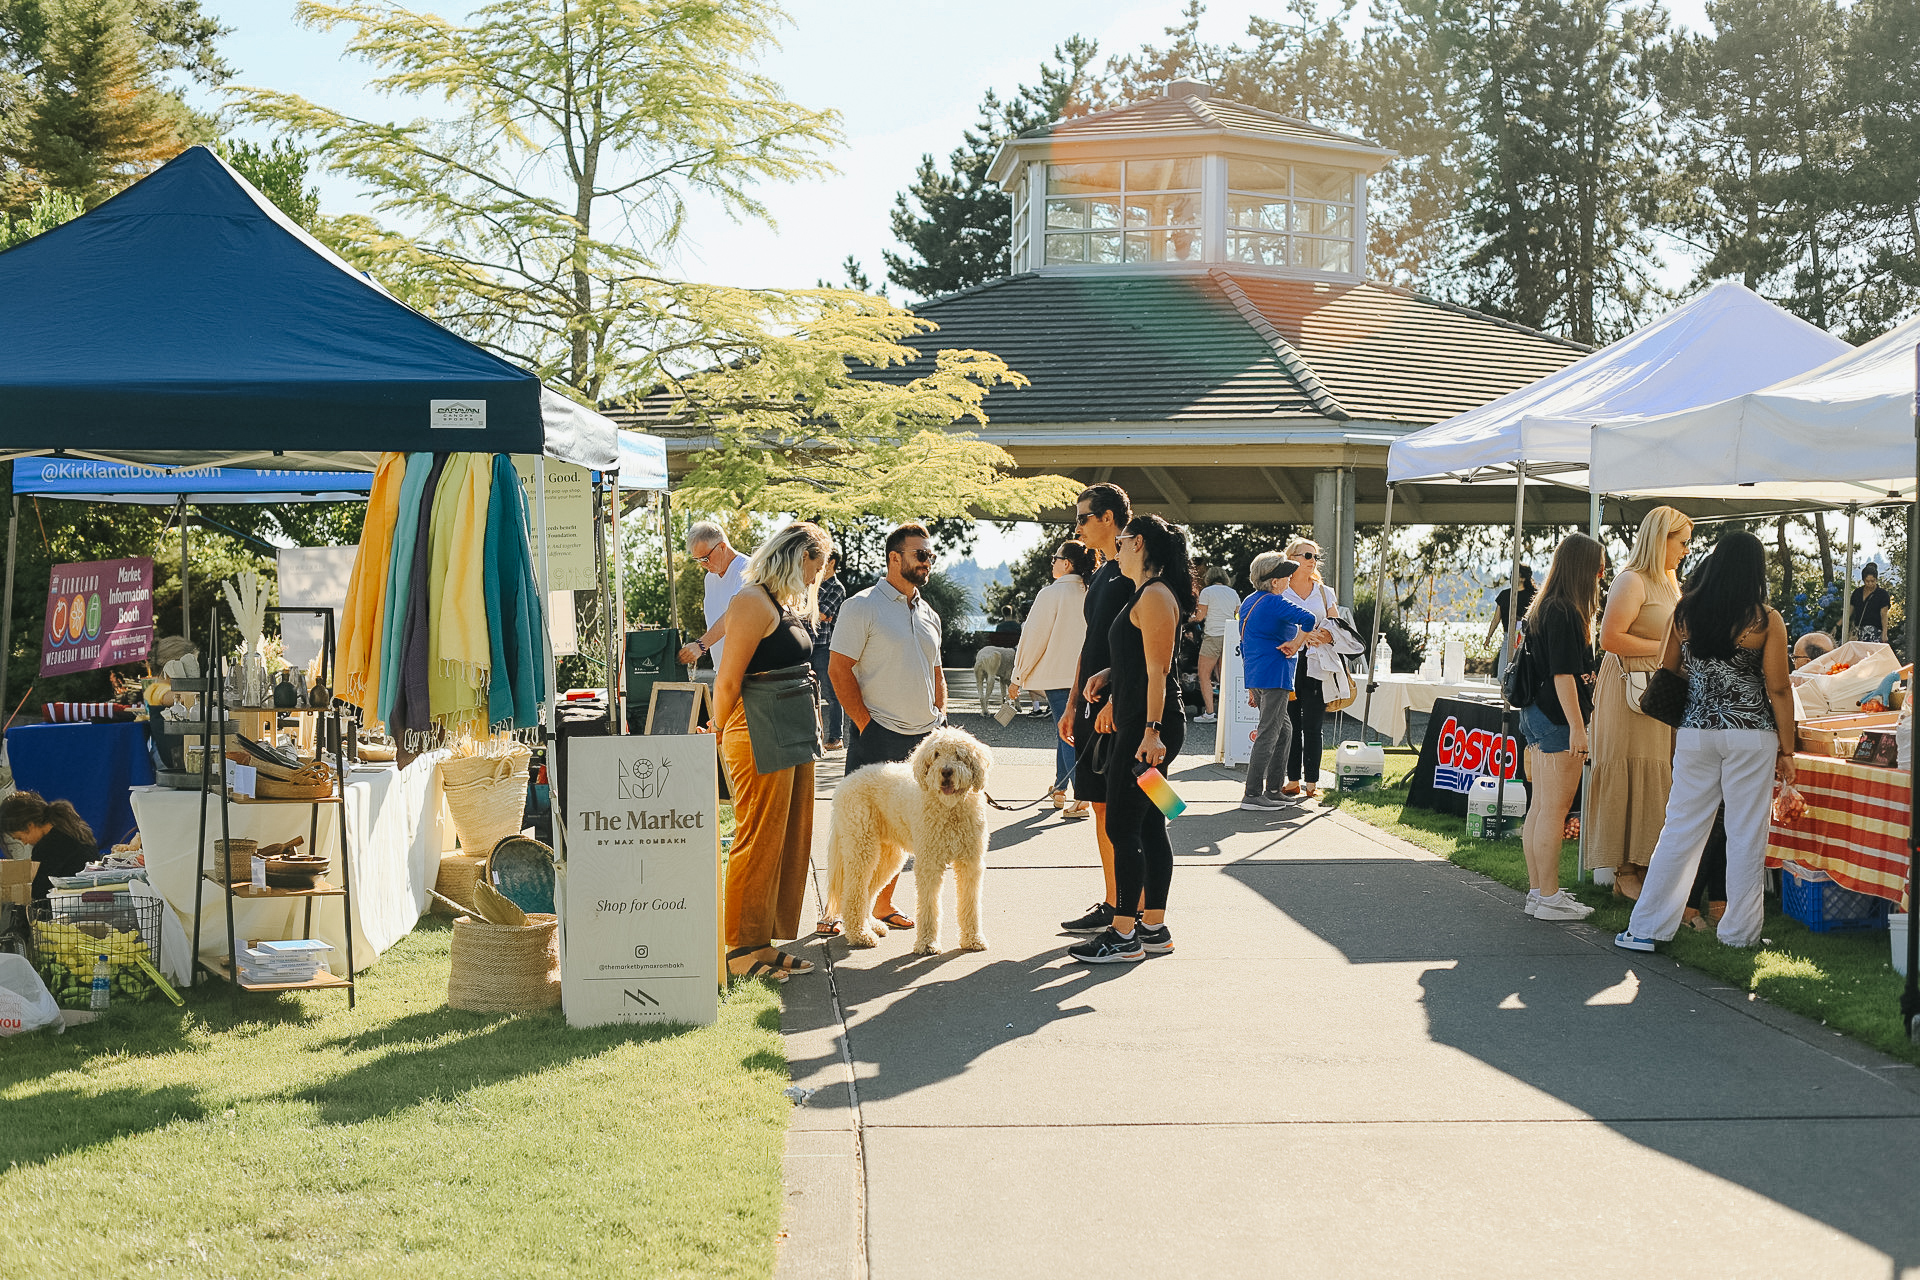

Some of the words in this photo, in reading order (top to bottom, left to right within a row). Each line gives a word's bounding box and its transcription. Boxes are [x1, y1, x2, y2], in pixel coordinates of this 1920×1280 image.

[41, 463, 222, 483] @KirklandDowtown
[548, 471, 581, 484] Good.
[118, 566, 142, 583] Market
[61, 575, 99, 594] KIRKLAND
[108, 585, 150, 605] Information
[118, 605, 140, 624] Booth
[45, 648, 78, 666] WEDNESDAY
[80, 644, 101, 660] MARKET
[1437, 715, 1518, 780] COSTCO
[579, 810, 622, 832] The
[626, 808, 704, 831] Market
[639, 837, 687, 845] ROMBAKH
[595, 899, 627, 914] Shop
[629, 898, 649, 914] for
[651, 897, 688, 911] Good.
[598, 962, 685, 971] @themarketbymaxrombakh
